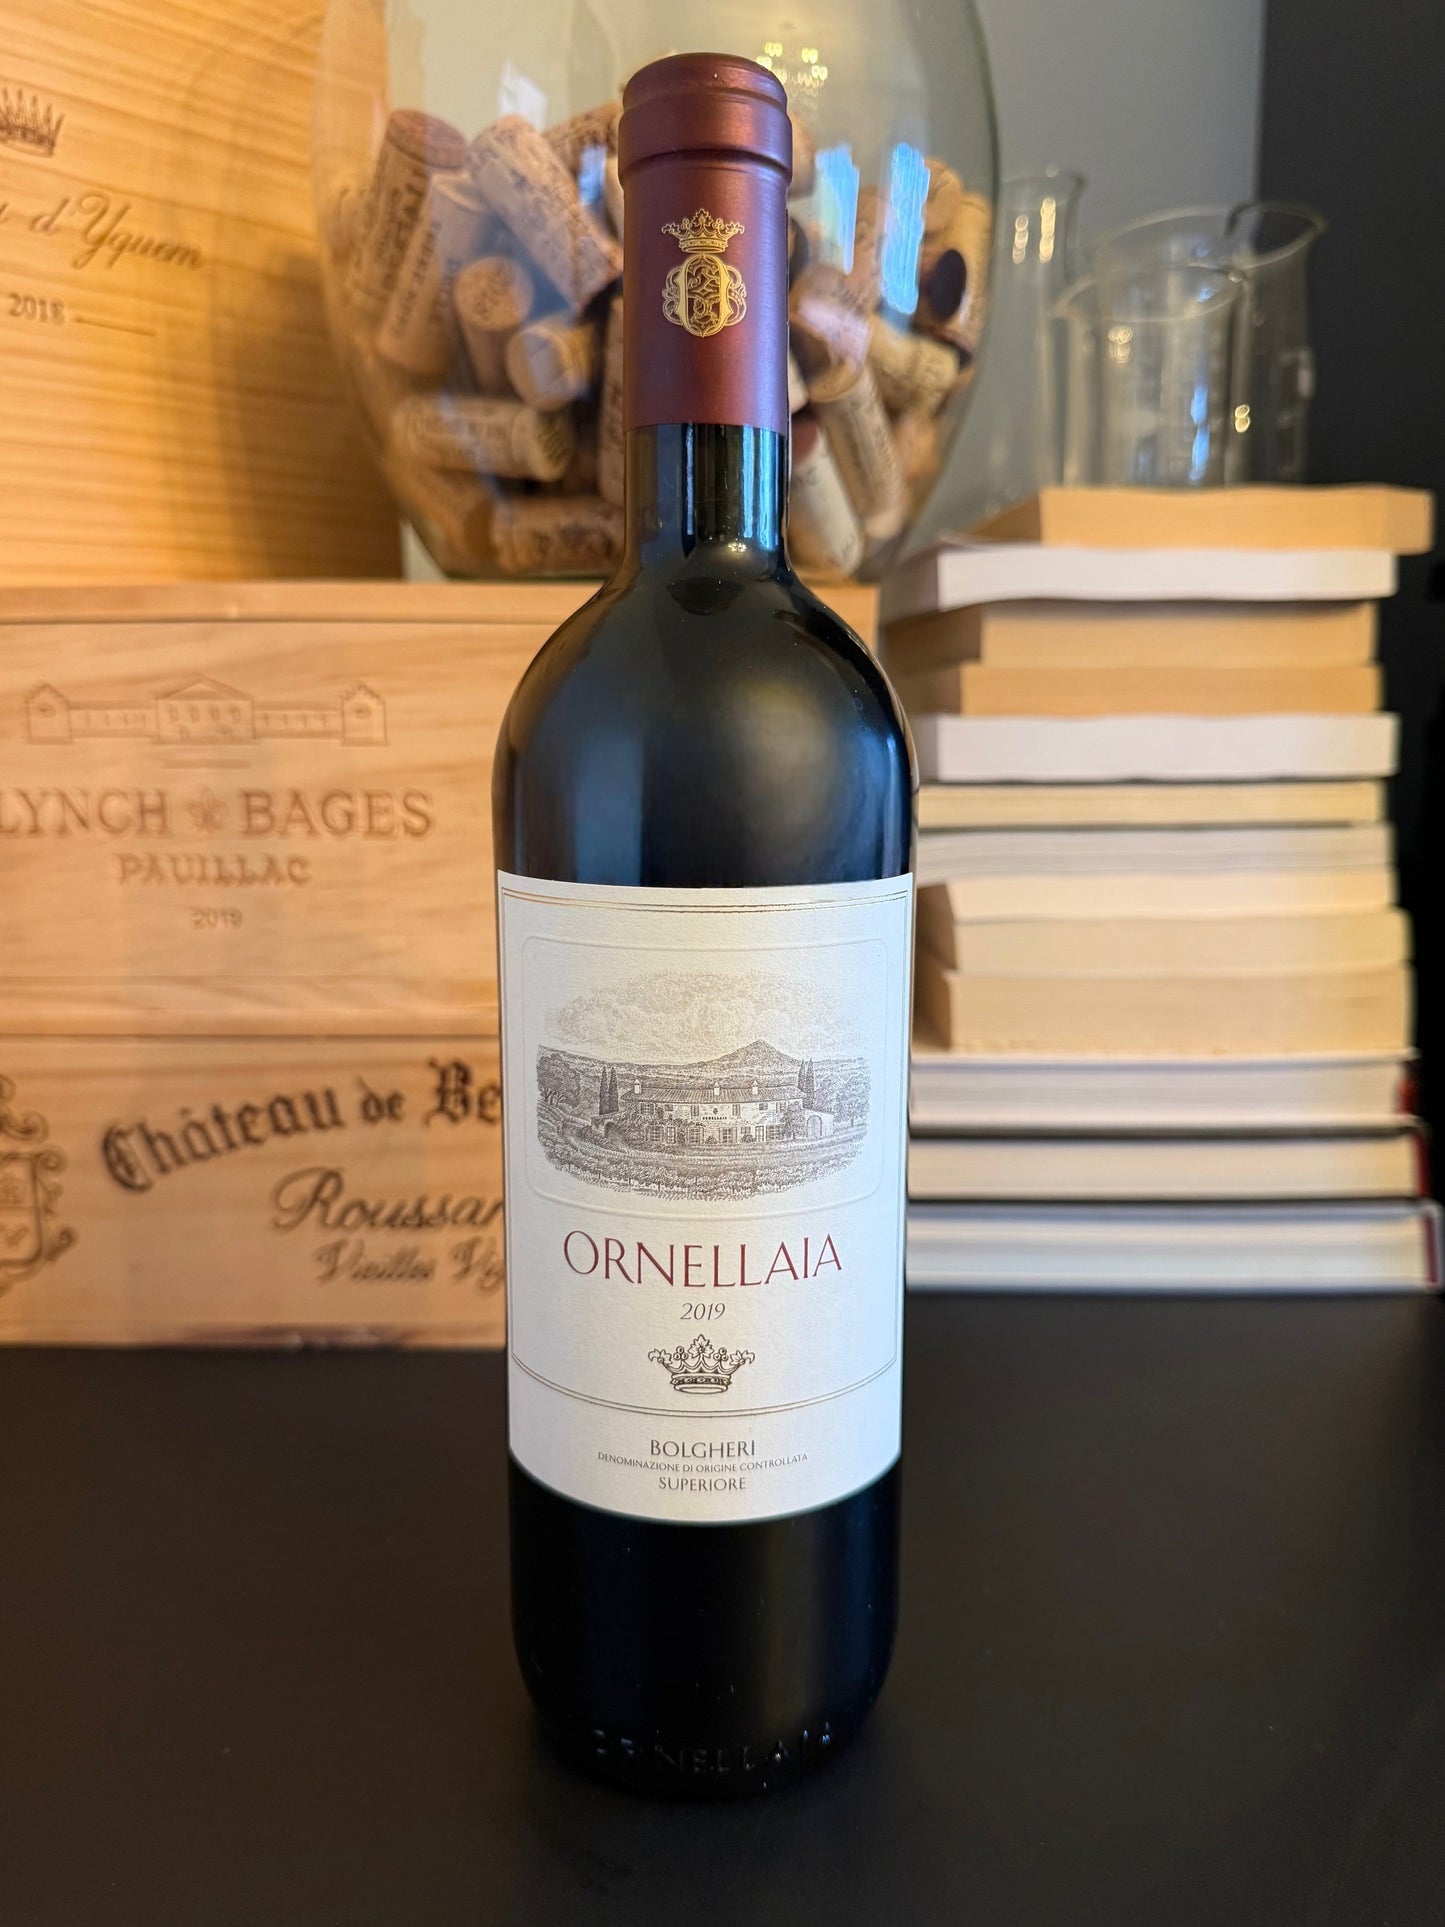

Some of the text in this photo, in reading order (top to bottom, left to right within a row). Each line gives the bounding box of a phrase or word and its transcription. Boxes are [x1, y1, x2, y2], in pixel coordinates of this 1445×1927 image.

[8, 293, 65, 326] 2018
[0, 787, 436, 840] LYNCH BAGES
[117, 853, 312, 888] PAUILLAC
[99, 1087, 350, 1194] Château
[355, 1075, 407, 1124] de
[563, 1230, 843, 1288] ORNELLAIA
[680, 1302, 726, 1321] 2019
[598, 1451, 809, 1473] DENOMINAZIONE DI ORIGINE CONTROLLATA
[650, 1439, 756, 1459] BOLGHERI
[658, 1476, 747, 1493] SUPERIORE
